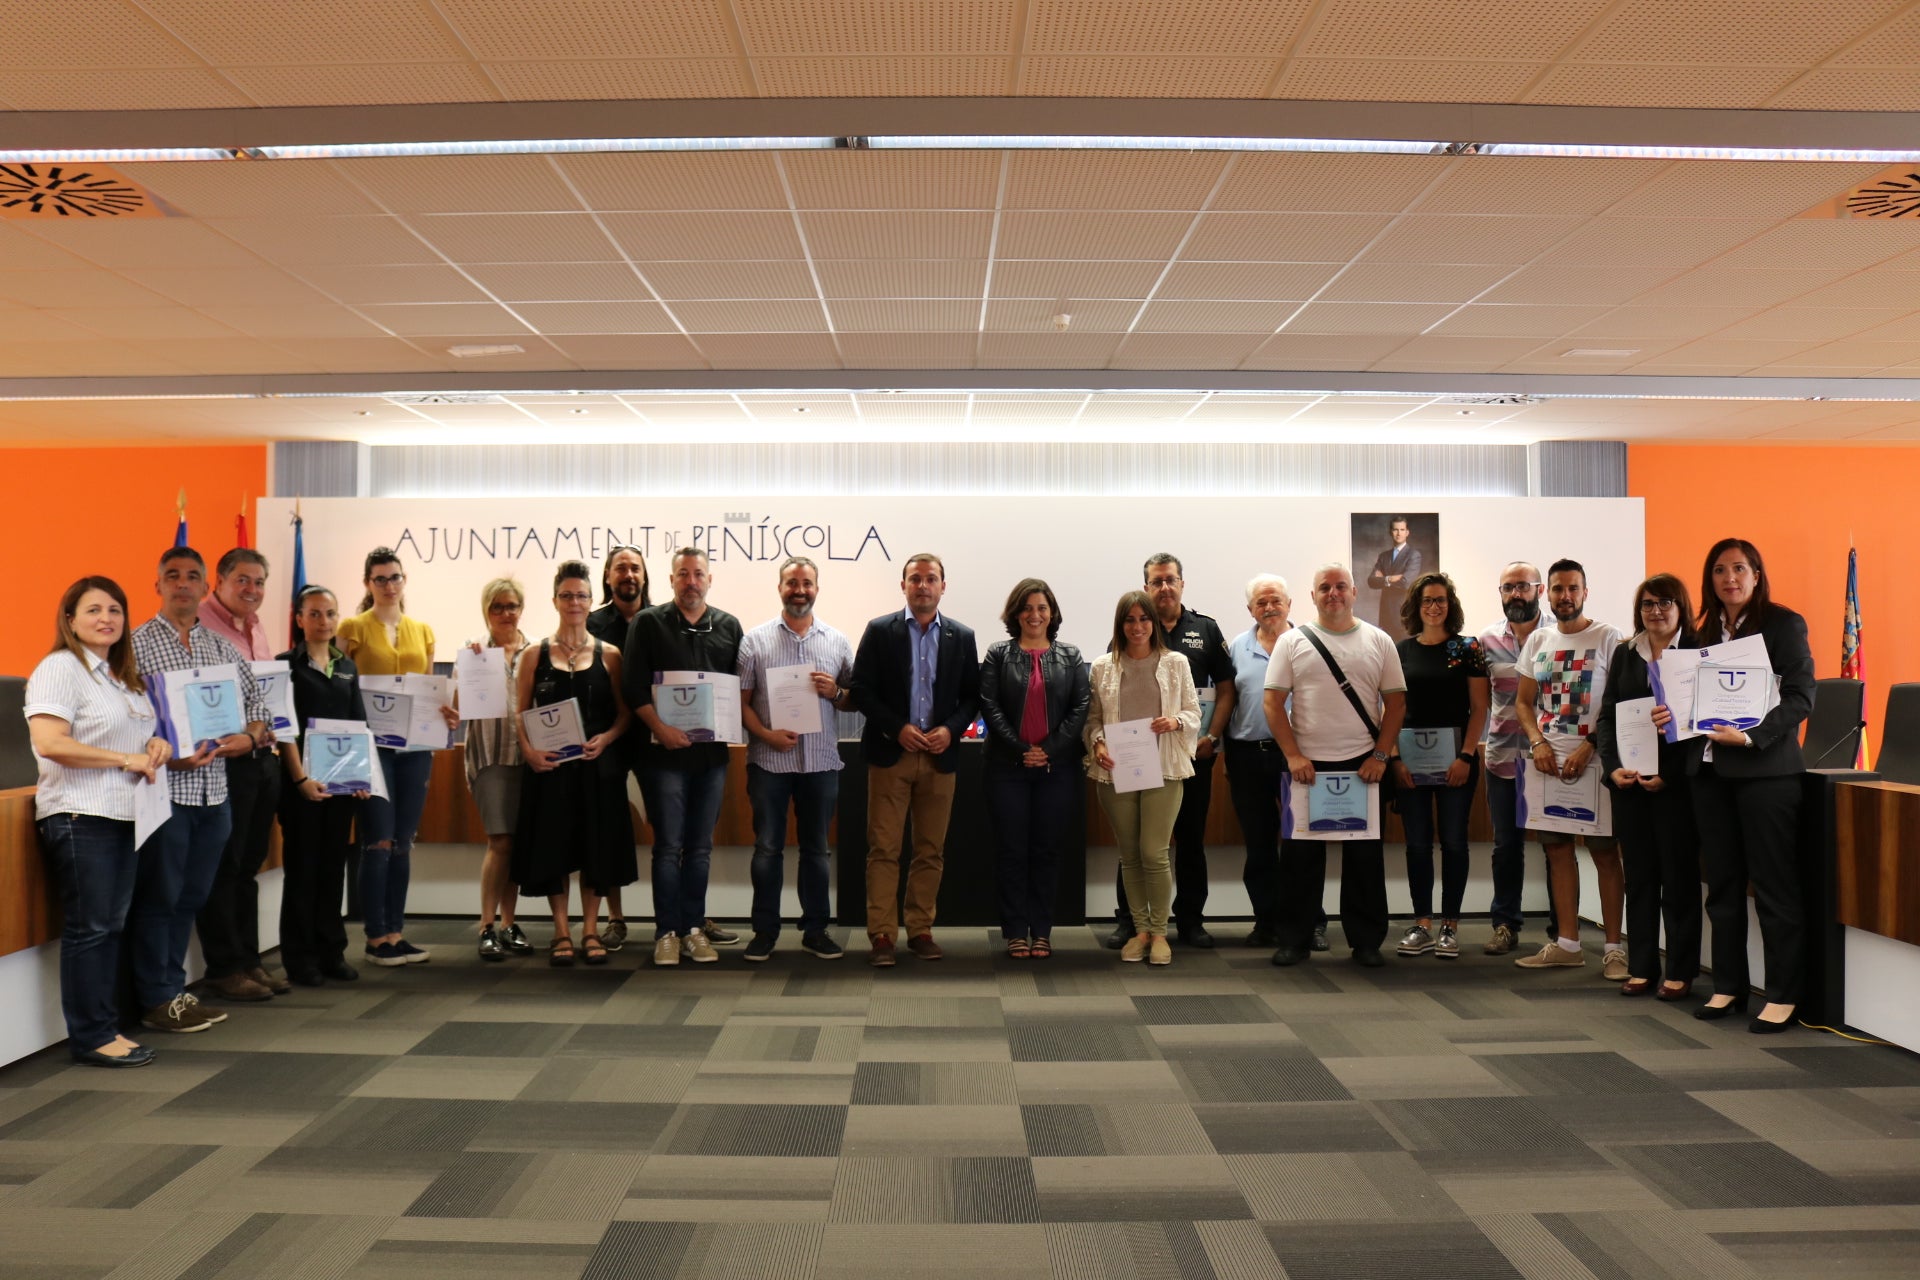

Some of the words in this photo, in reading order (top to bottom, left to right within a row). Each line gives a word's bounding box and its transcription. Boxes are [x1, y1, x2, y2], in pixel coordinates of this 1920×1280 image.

[395, 526, 656, 563] AJUNTAMENT
[664, 531, 681, 554] DE
[692, 515, 892, 562] PENÍSCOLA
